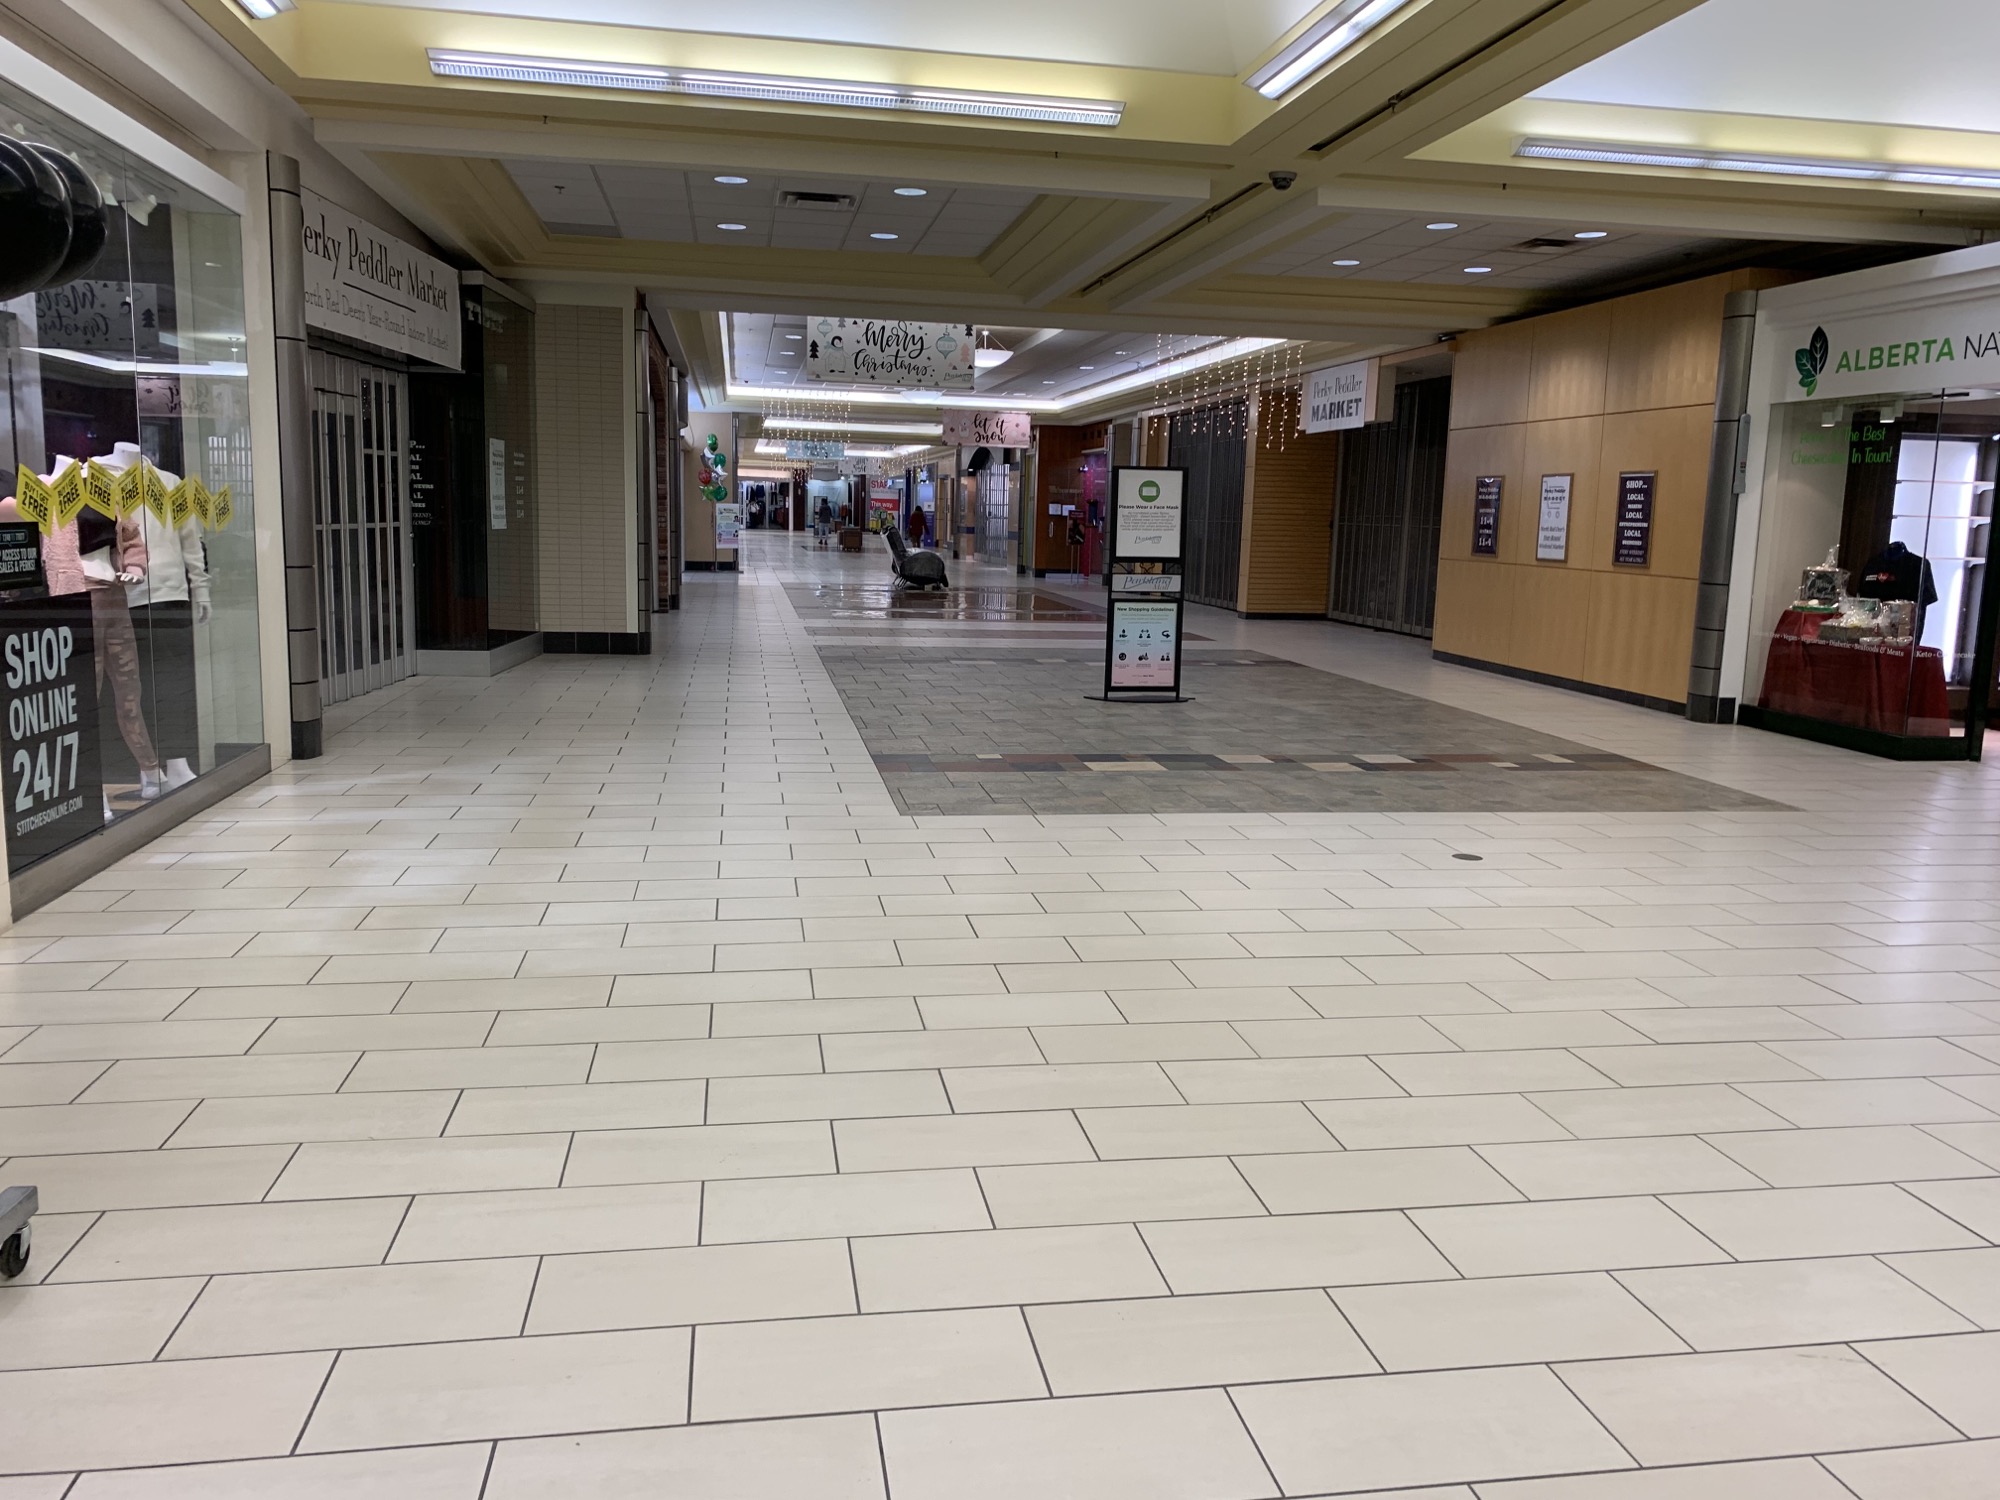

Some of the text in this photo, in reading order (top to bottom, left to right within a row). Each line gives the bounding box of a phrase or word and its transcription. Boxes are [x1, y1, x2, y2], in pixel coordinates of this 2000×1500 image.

[301, 205, 448, 312] erky Peddler Market
[305, 282, 324, 309] orth
[863, 320, 932, 359] Merry
[851, 349, 932, 376] Christmas
[1835, 332, 2000, 373] ALBERTA NA
[1314, 374, 1362, 402] Perky Peddler
[1311, 398, 1362, 422] MARKET
[974, 413, 1008, 434] let it
[1862, 425, 1887, 441] Best
[974, 432, 1006, 444] snow
[1852, 448, 1862, 464] In
[1864, 446, 1893, 463] Town!
[24, 481, 36, 495] BUY
[39, 492, 49, 505] GET
[57, 487, 66, 498] BUY
[68, 474, 76, 487] GET
[91, 472, 100, 484] BUY
[103, 480, 112, 491] GET
[1626, 480, 1648, 488] SHOP...
[22, 491, 48, 522] 2 FREE
[62, 483, 80, 510] FREE
[93, 484, 111, 508] FREE
[150, 488, 164, 515] FREE
[2, 547, 37, 561] ACCESS TO OUR
[1783, 633, 1798, 641] Vegan
[1829, 639, 1851, 648] Diabetic
[1854, 643, 1879, 652] Seafoods
[1886, 648, 1904, 656] Meats
[1916, 650, 1932, 658] Keto
[4, 626, 73, 690] SHOP
[9, 684, 78, 741] ONLINE
[13, 731, 78, 813] 24/7
[16, 796, 83, 836] STITCHESONLINE.COM
